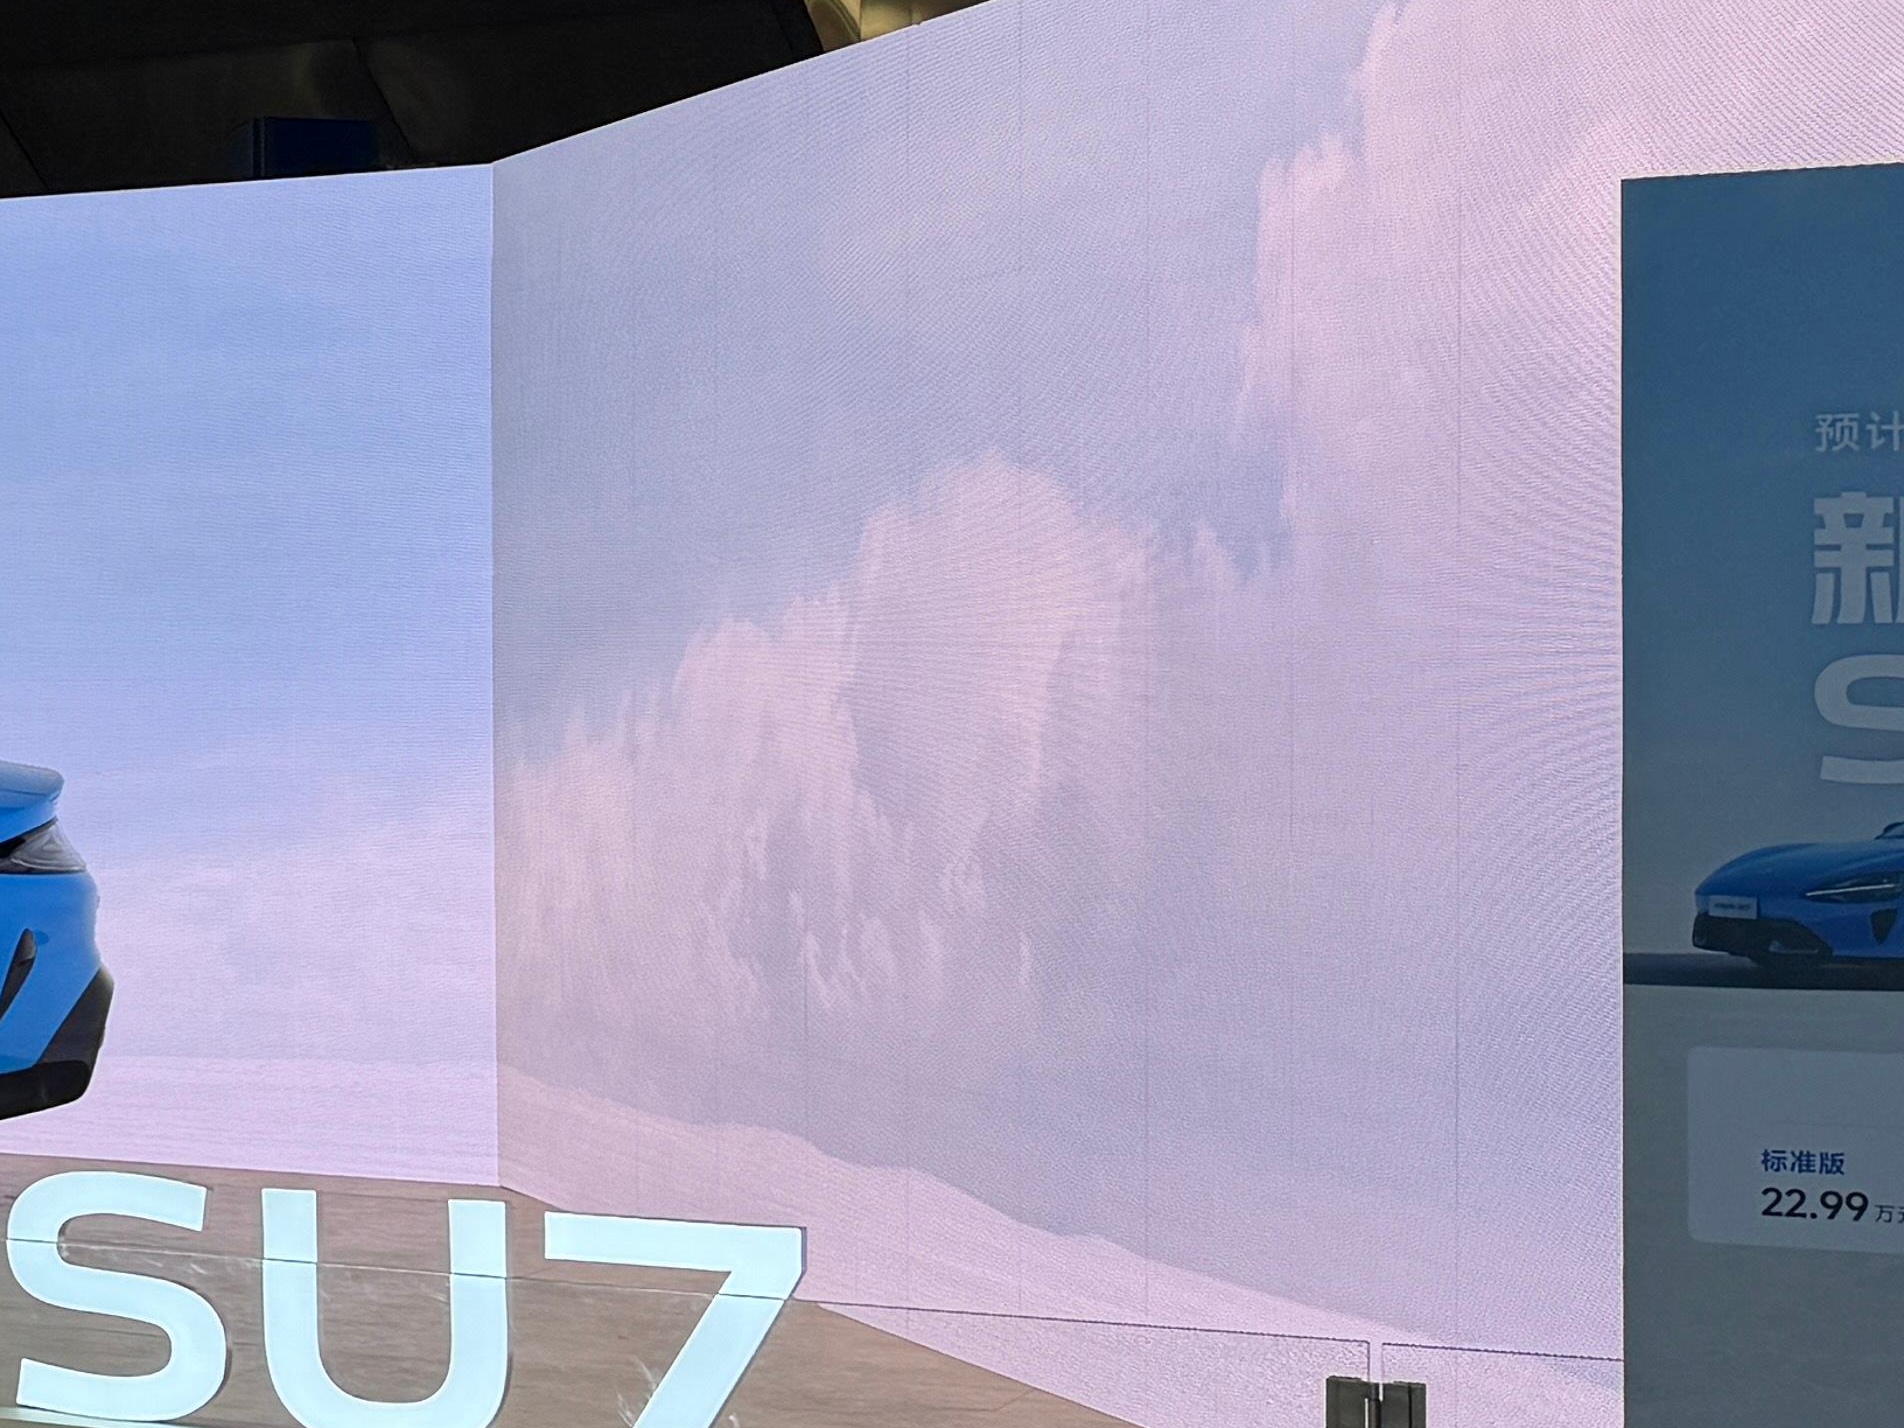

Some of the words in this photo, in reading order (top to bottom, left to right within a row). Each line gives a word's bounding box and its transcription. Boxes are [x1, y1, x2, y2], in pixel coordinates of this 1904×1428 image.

[1761, 1149, 1845, 1176] 标准版
[1761, 1187, 1869, 1221] 22.99
